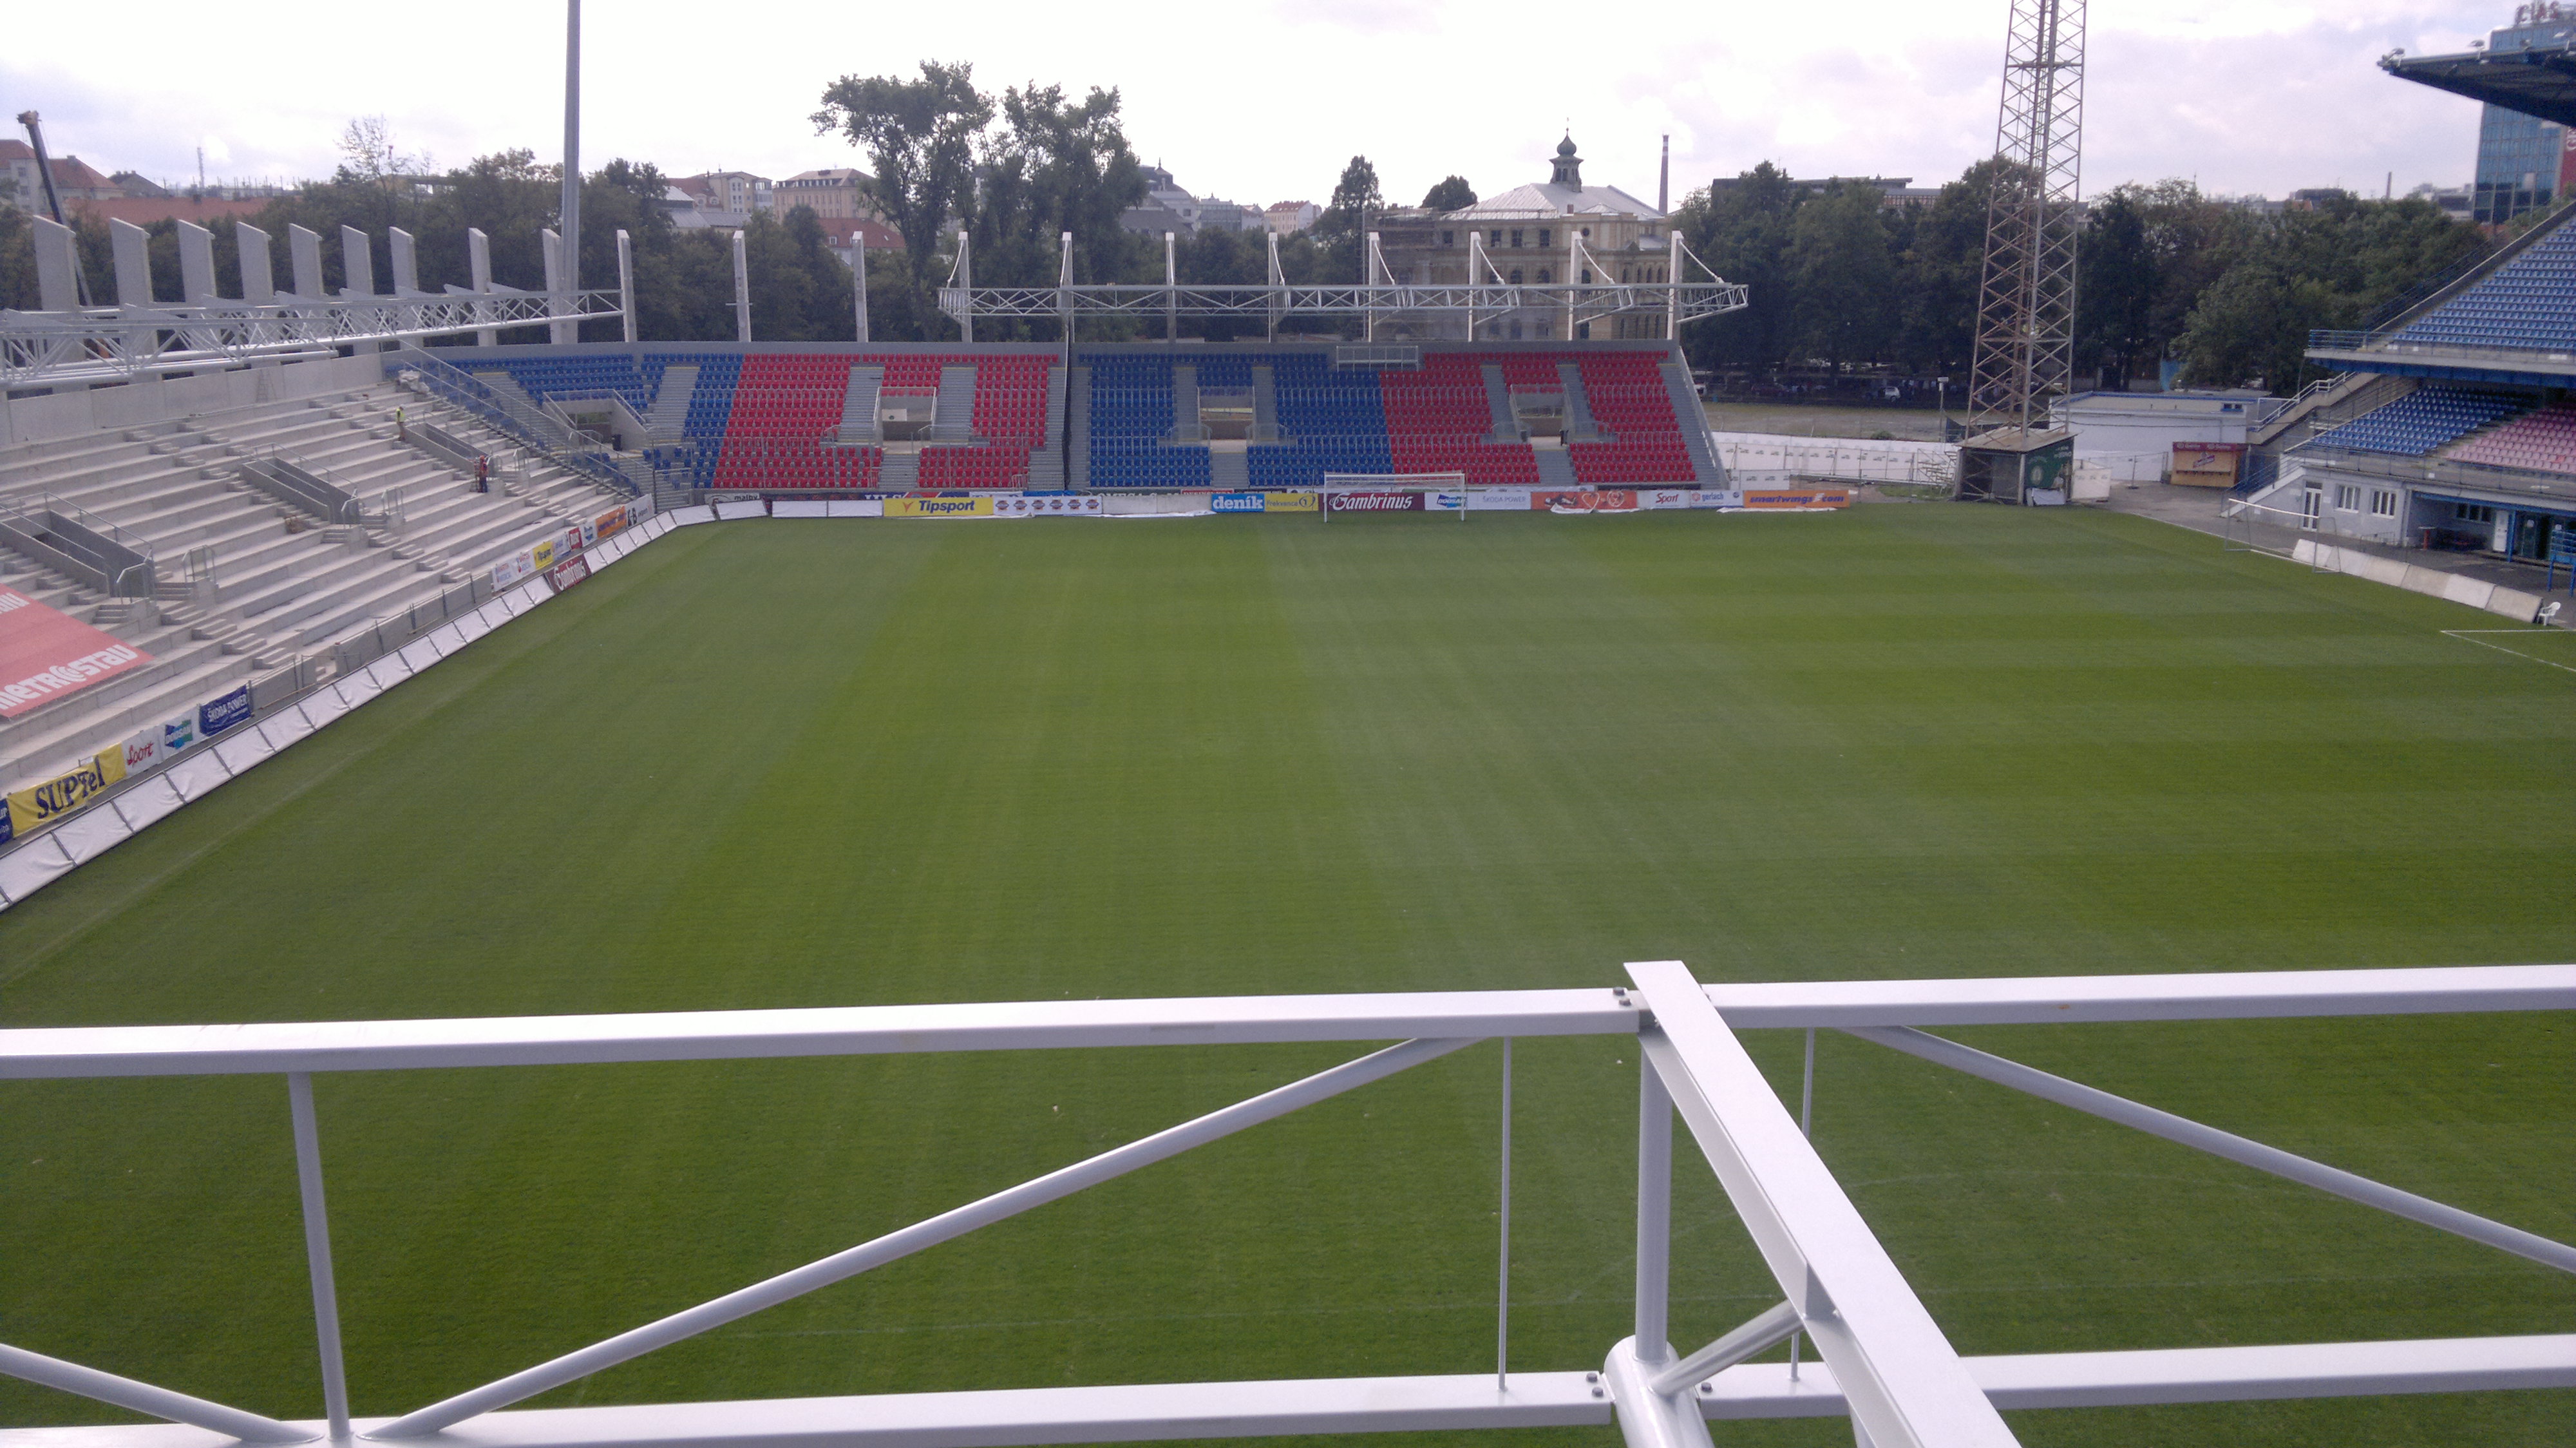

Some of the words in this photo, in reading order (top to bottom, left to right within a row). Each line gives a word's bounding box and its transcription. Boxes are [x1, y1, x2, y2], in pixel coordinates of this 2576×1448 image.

[1213, 496, 1264, 510] deník
[1331, 493, 1414, 511] Gambrinus
[1656, 492, 1679, 504] Sport
[1701, 492, 1724, 502] gerlach
[918, 500, 975, 513] Tipsport
[554, 560, 587, 591] Gambrinus
